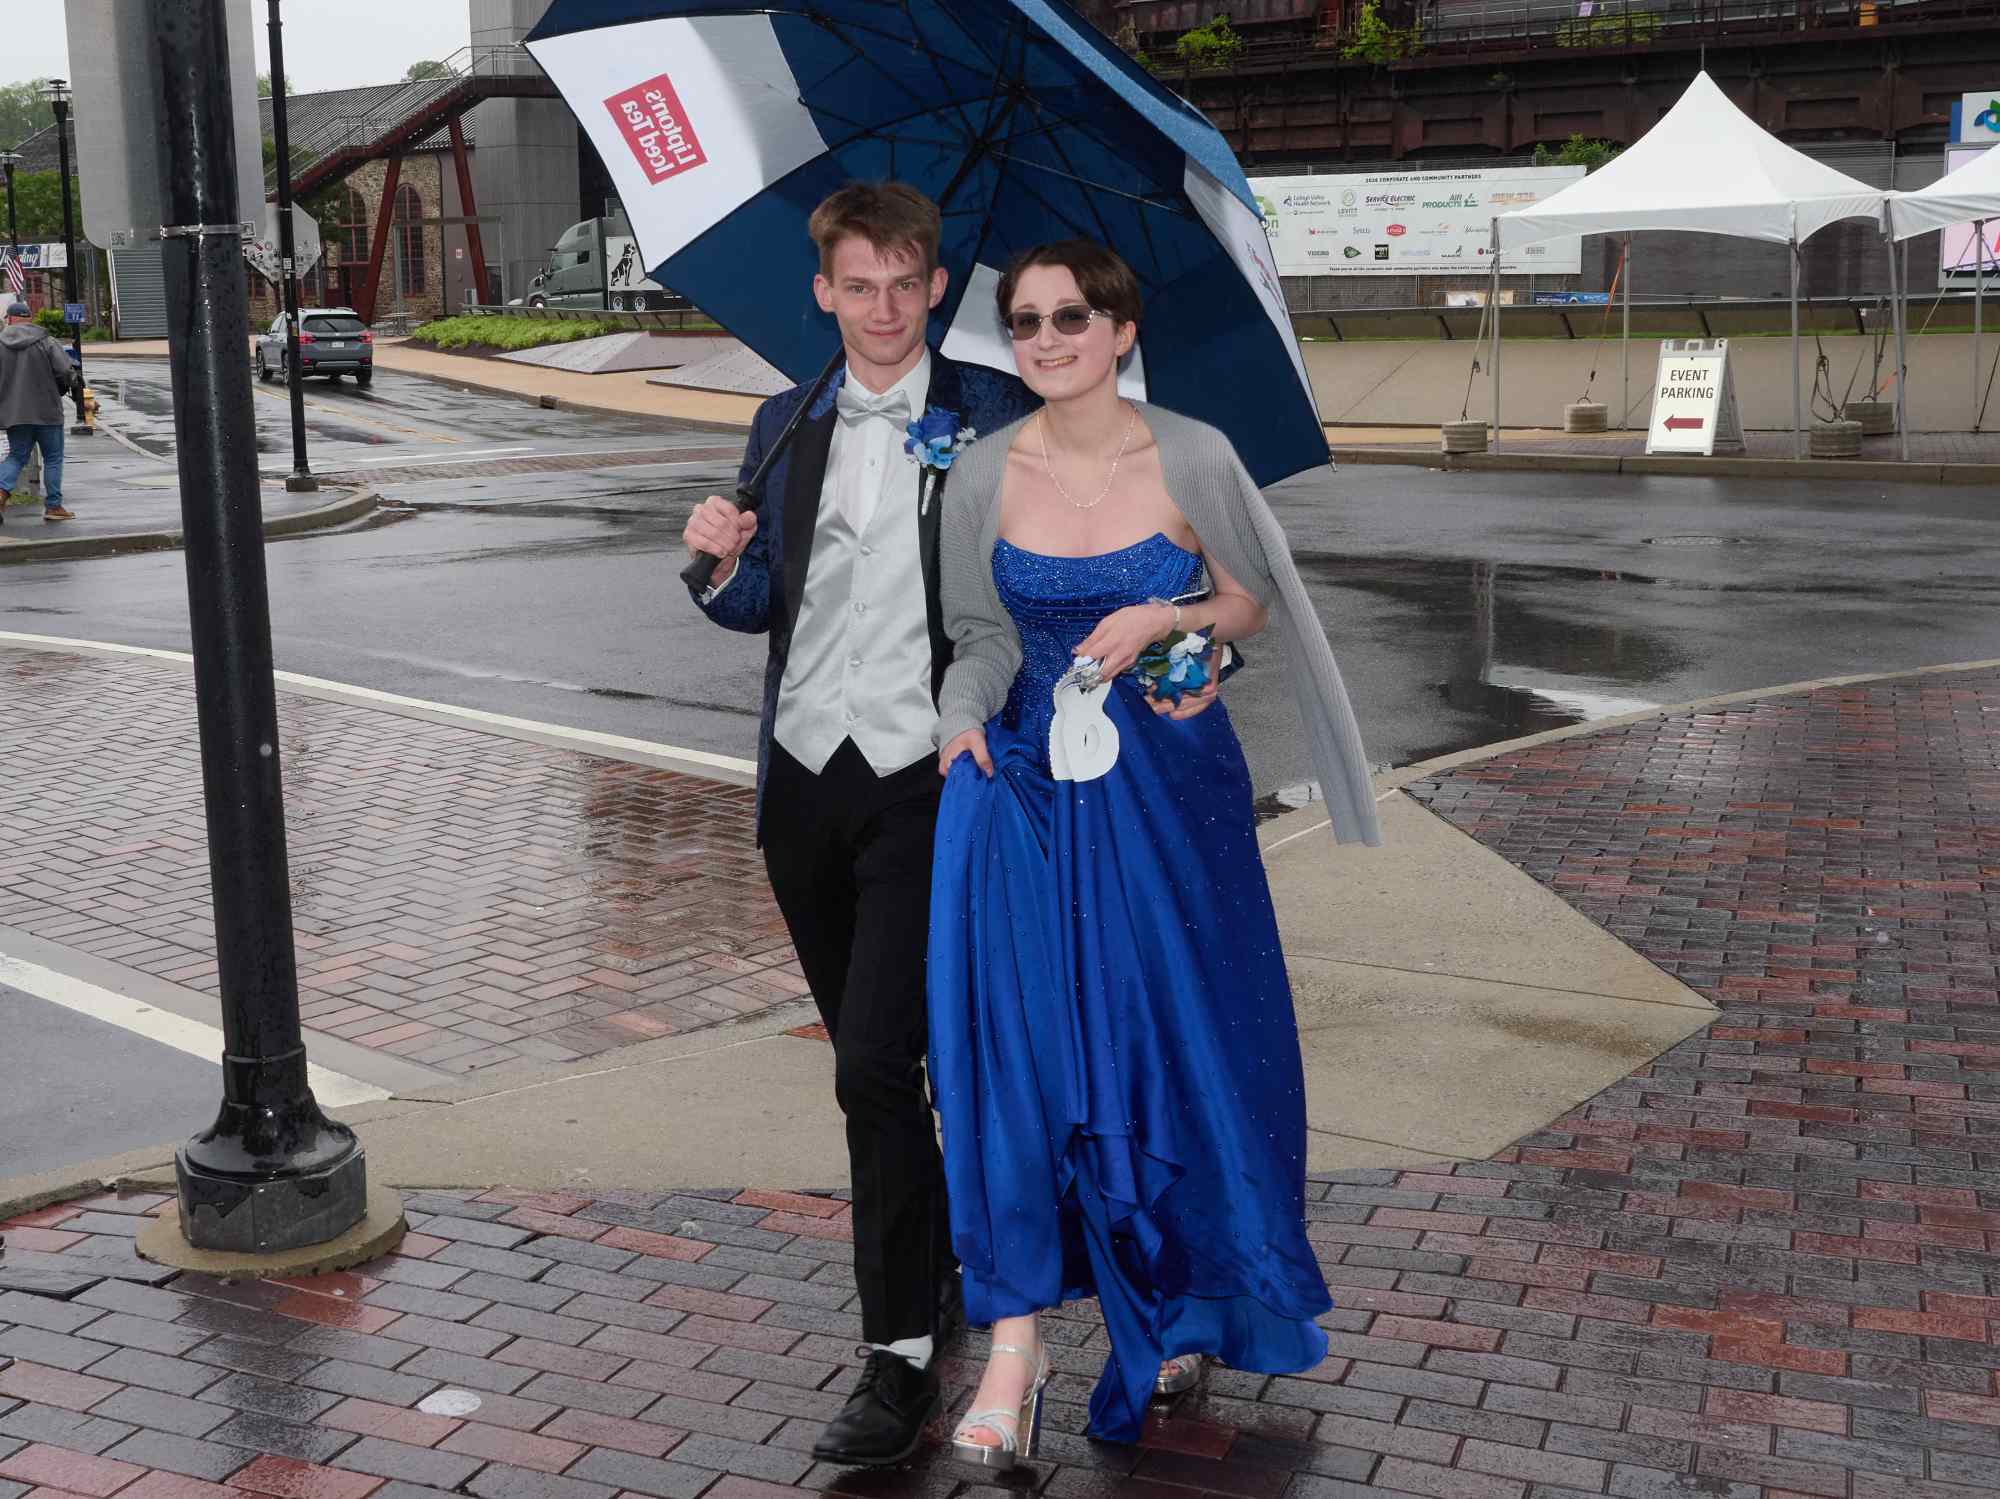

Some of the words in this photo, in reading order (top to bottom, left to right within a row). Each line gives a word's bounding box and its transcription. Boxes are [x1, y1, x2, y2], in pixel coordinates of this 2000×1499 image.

[1366, 195, 1390, 204] SERVICE
[1390, 194, 1416, 202] ELECTRIC
[1422, 200, 1462, 209] PRODUCTS
[1670, 369, 1709, 381] EVENT
[1661, 387, 1714, 399] PARKING
